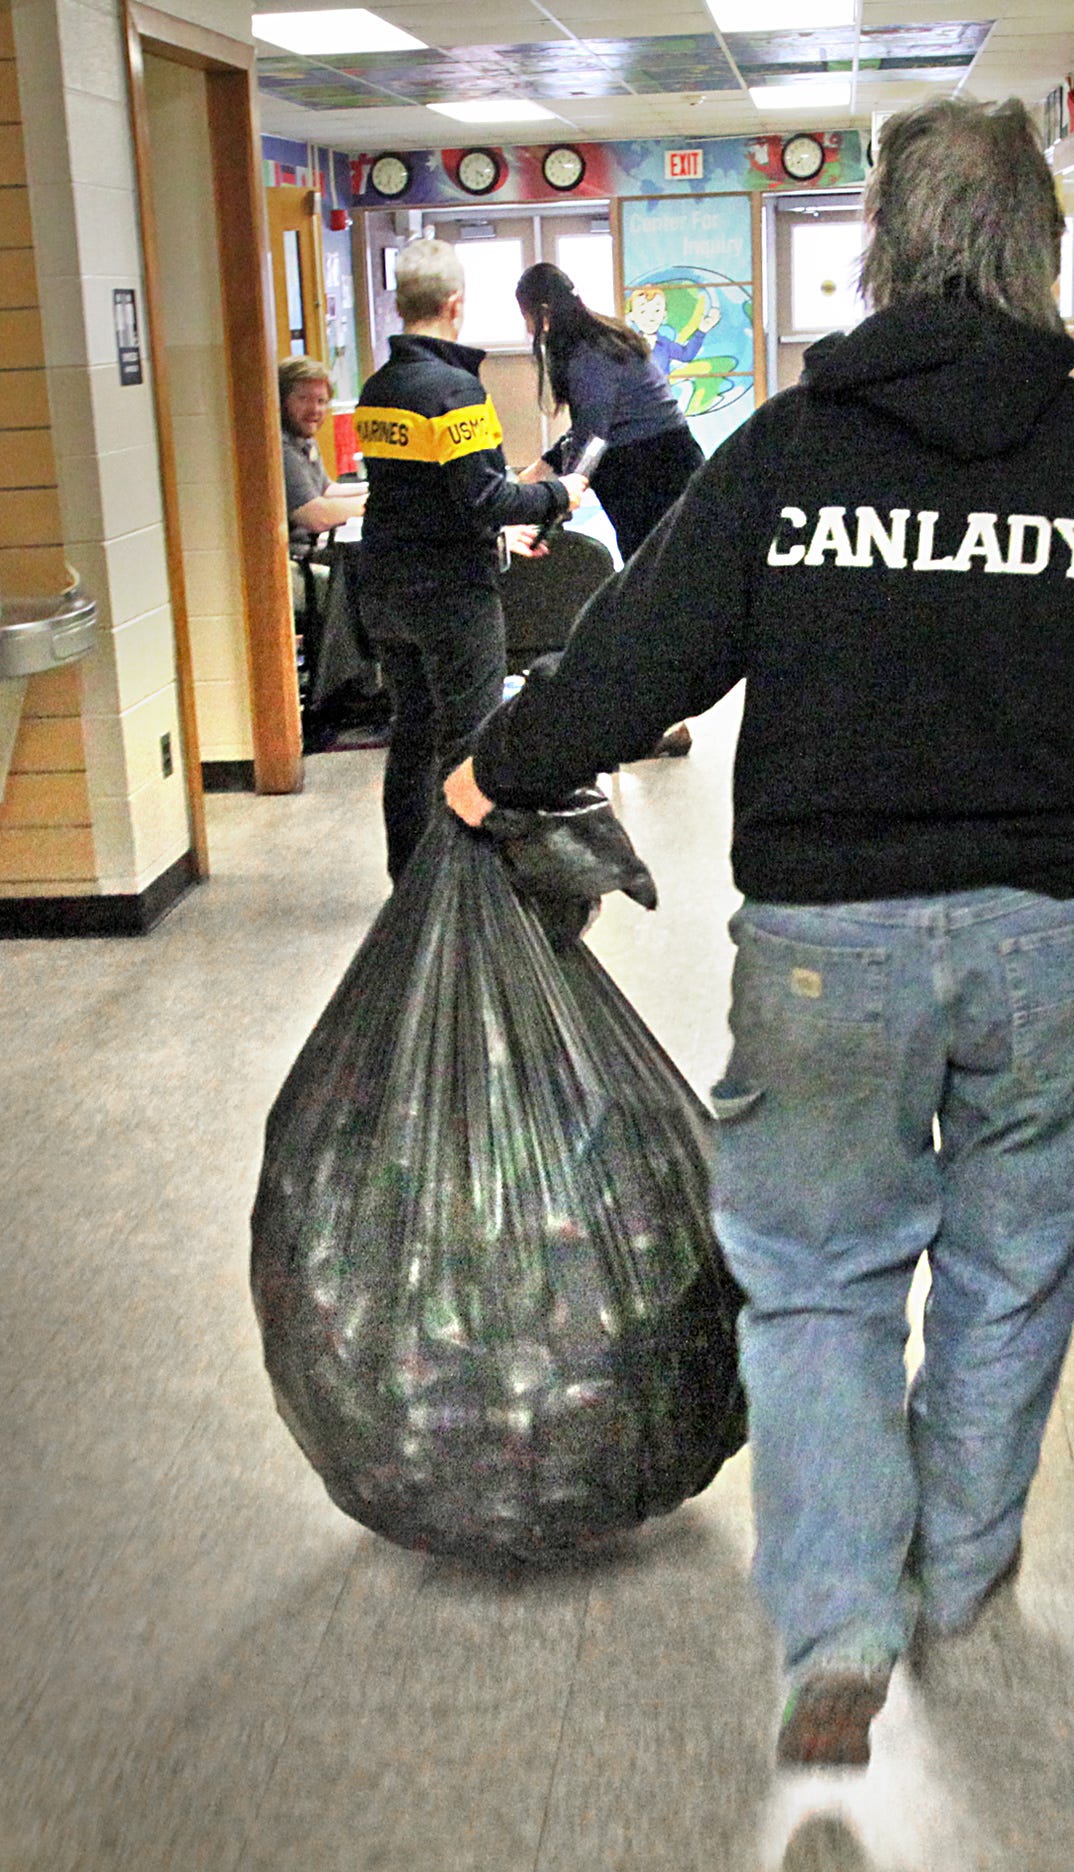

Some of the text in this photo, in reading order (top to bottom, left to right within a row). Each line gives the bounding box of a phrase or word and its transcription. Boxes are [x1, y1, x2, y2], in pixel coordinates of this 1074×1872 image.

[670, 152, 699, 176] EXIT
[629, 210, 719, 233] Center For
[682, 235, 744, 258] Inquiry
